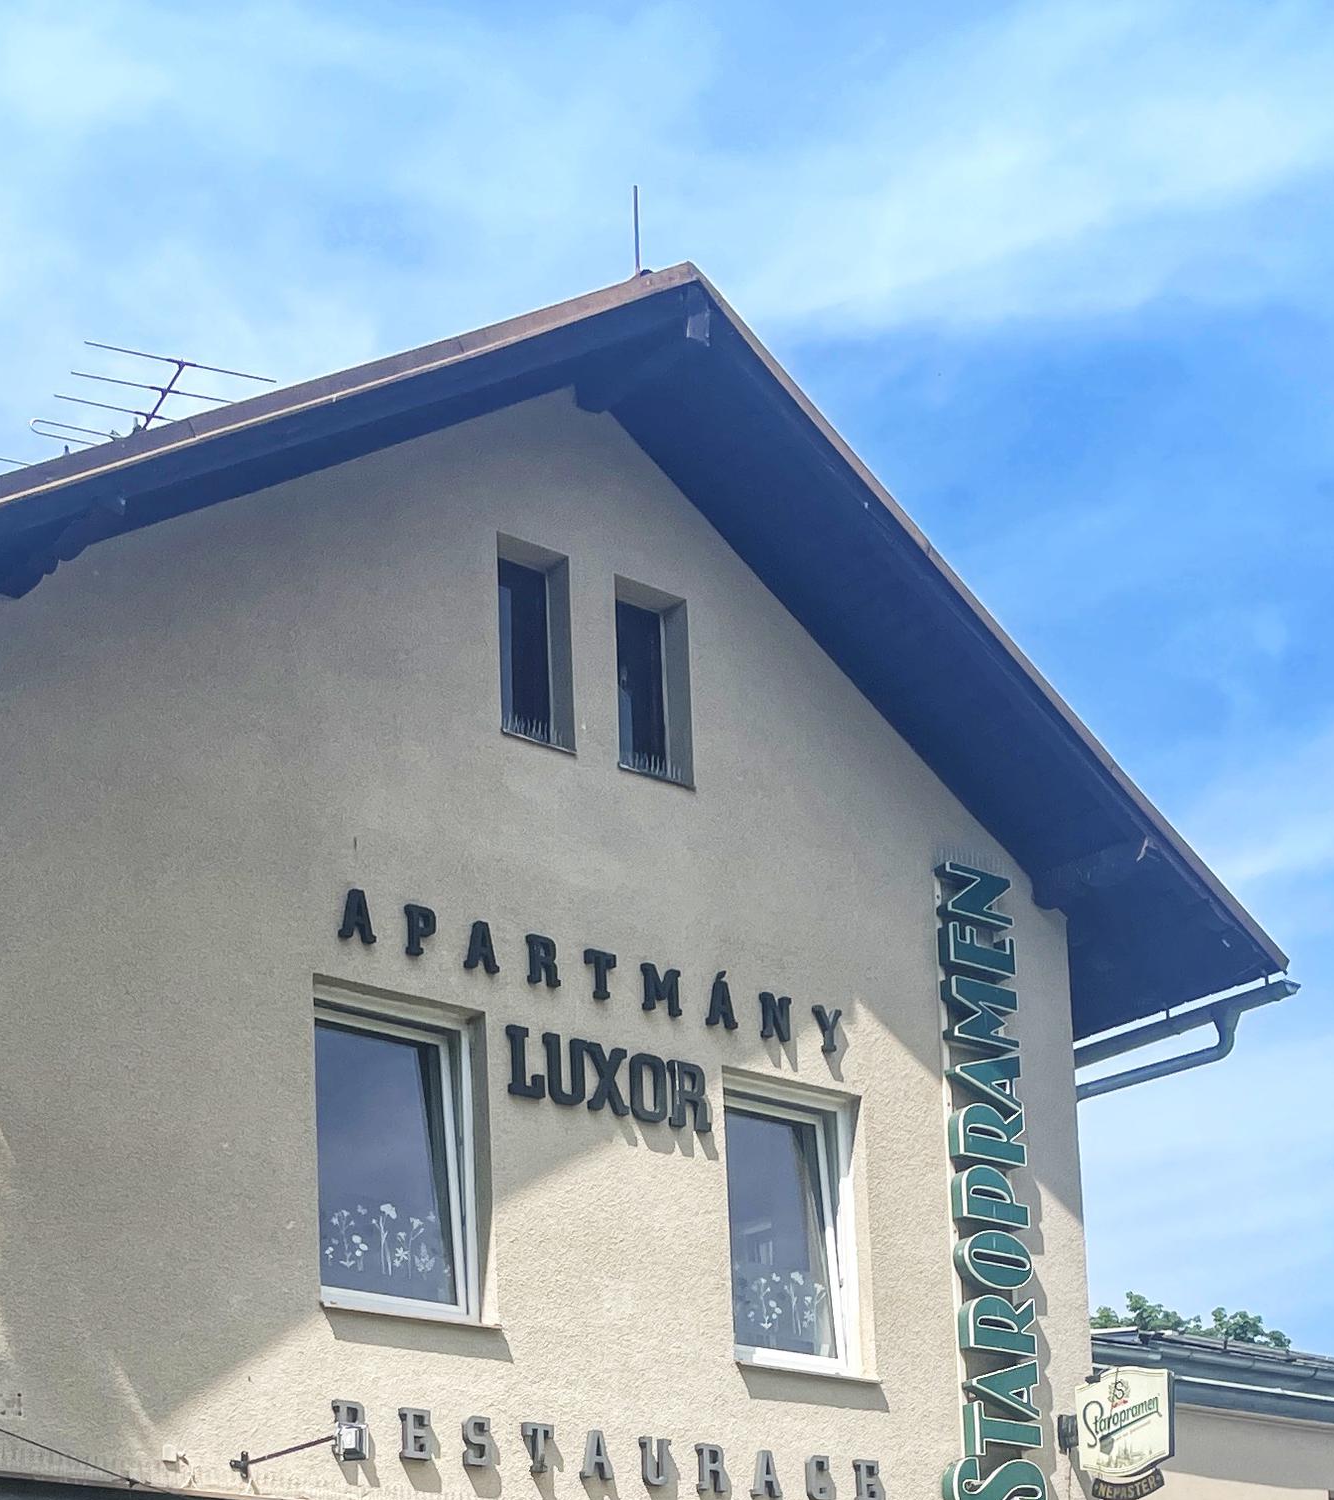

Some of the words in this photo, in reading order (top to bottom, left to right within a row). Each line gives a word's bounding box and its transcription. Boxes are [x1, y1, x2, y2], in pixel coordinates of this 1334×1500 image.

[337, 888, 844, 1053] APARTMÁNY
[505, 1024, 712, 1133] LUXOR
[1083, 1397, 1162, 1447] Staropramen
